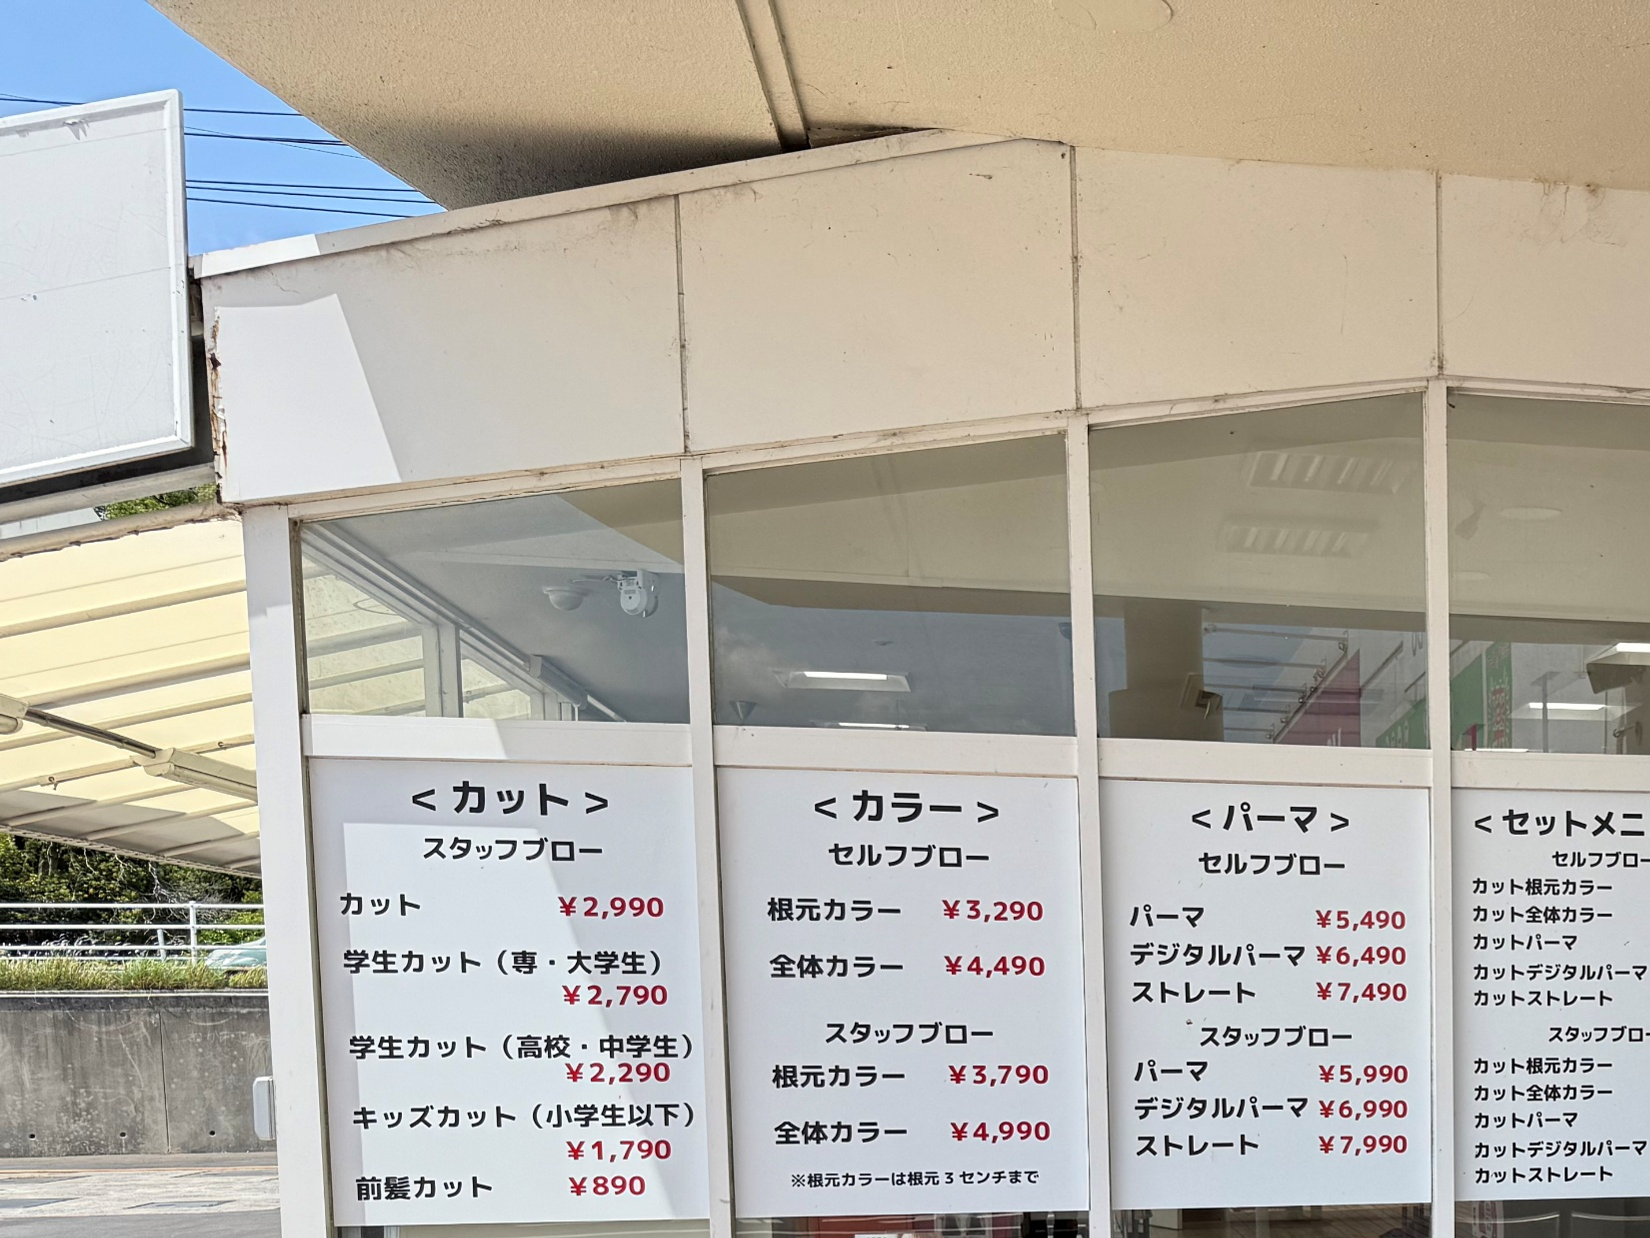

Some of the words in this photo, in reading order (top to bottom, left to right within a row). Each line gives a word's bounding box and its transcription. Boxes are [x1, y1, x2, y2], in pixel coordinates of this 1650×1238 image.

[424, 837, 602, 861] スタッフブロー
[829, 844, 989, 867] セルフブロー
[1199, 853, 1345, 875] セルフブロー
[1473, 878, 1612, 895] カット根元カラー
[340, 893, 420, 916] カット
[558, 897, 663, 919] ¥2,990
[768, 898, 900, 921] 根元カラー
[943, 900, 1042, 922] ¥3,290
[1473, 906, 1612, 923] カット全体カラー
[1130, 904, 1203, 927] パーマ
[1316, 910, 1405, 931] ¥5,490
[1474, 934, 1577, 950] カットパーマ
[1131, 943, 1304, 966] デジタルパーマ
[1316, 946, 1405, 967] ¥6,490
[770, 955, 903, 978] 全体カラー
[945, 956, 1044, 978] ¥4,490
[1474, 964, 1647, 980] カットデジタルパーマ
[562, 985, 667, 1007] ¥2,790
[1133, 982, 1255, 1003] ストレート
[1316, 983, 1406, 1003] ¥7,490
[1474, 990, 1612, 1006] カットストレート
[826, 1022, 993, 1044] スタッフブロー
[1201, 1026, 1352, 1046] スタッフブロー
[566, 1063, 670, 1084] ¥2,290
[772, 1065, 904, 1088] 根元カラー
[949, 1065, 1048, 1086] ¥3,790
[1135, 1060, 1207, 1081] パーマ
[1319, 1065, 1407, 1085] ¥5,990
[1474, 1058, 1612, 1074] カット根元カラー
[1475, 1085, 1612, 1101] カット全体カラー
[1135, 1096, 1307, 1120] デジタルパーマ
[1319, 1100, 1407, 1120] ¥6,990
[1475, 1112, 1577, 1128] カットパーマ
[775, 1121, 907, 1144] 全体カラー
[951, 1122, 1049, 1143] ¥4,990
[567, 1140, 671, 1162] ¥1,790
[1137, 1134, 1258, 1156] ストレート
[1319, 1135, 1407, 1156] ¥7,990
[1475, 1140, 1647, 1158] カットデジタルパーマ
[1476, 1166, 1612, 1183] カットストレート
[356, 1177, 492, 1200] 前髪カット
[569, 1176, 645, 1196] ¥890
